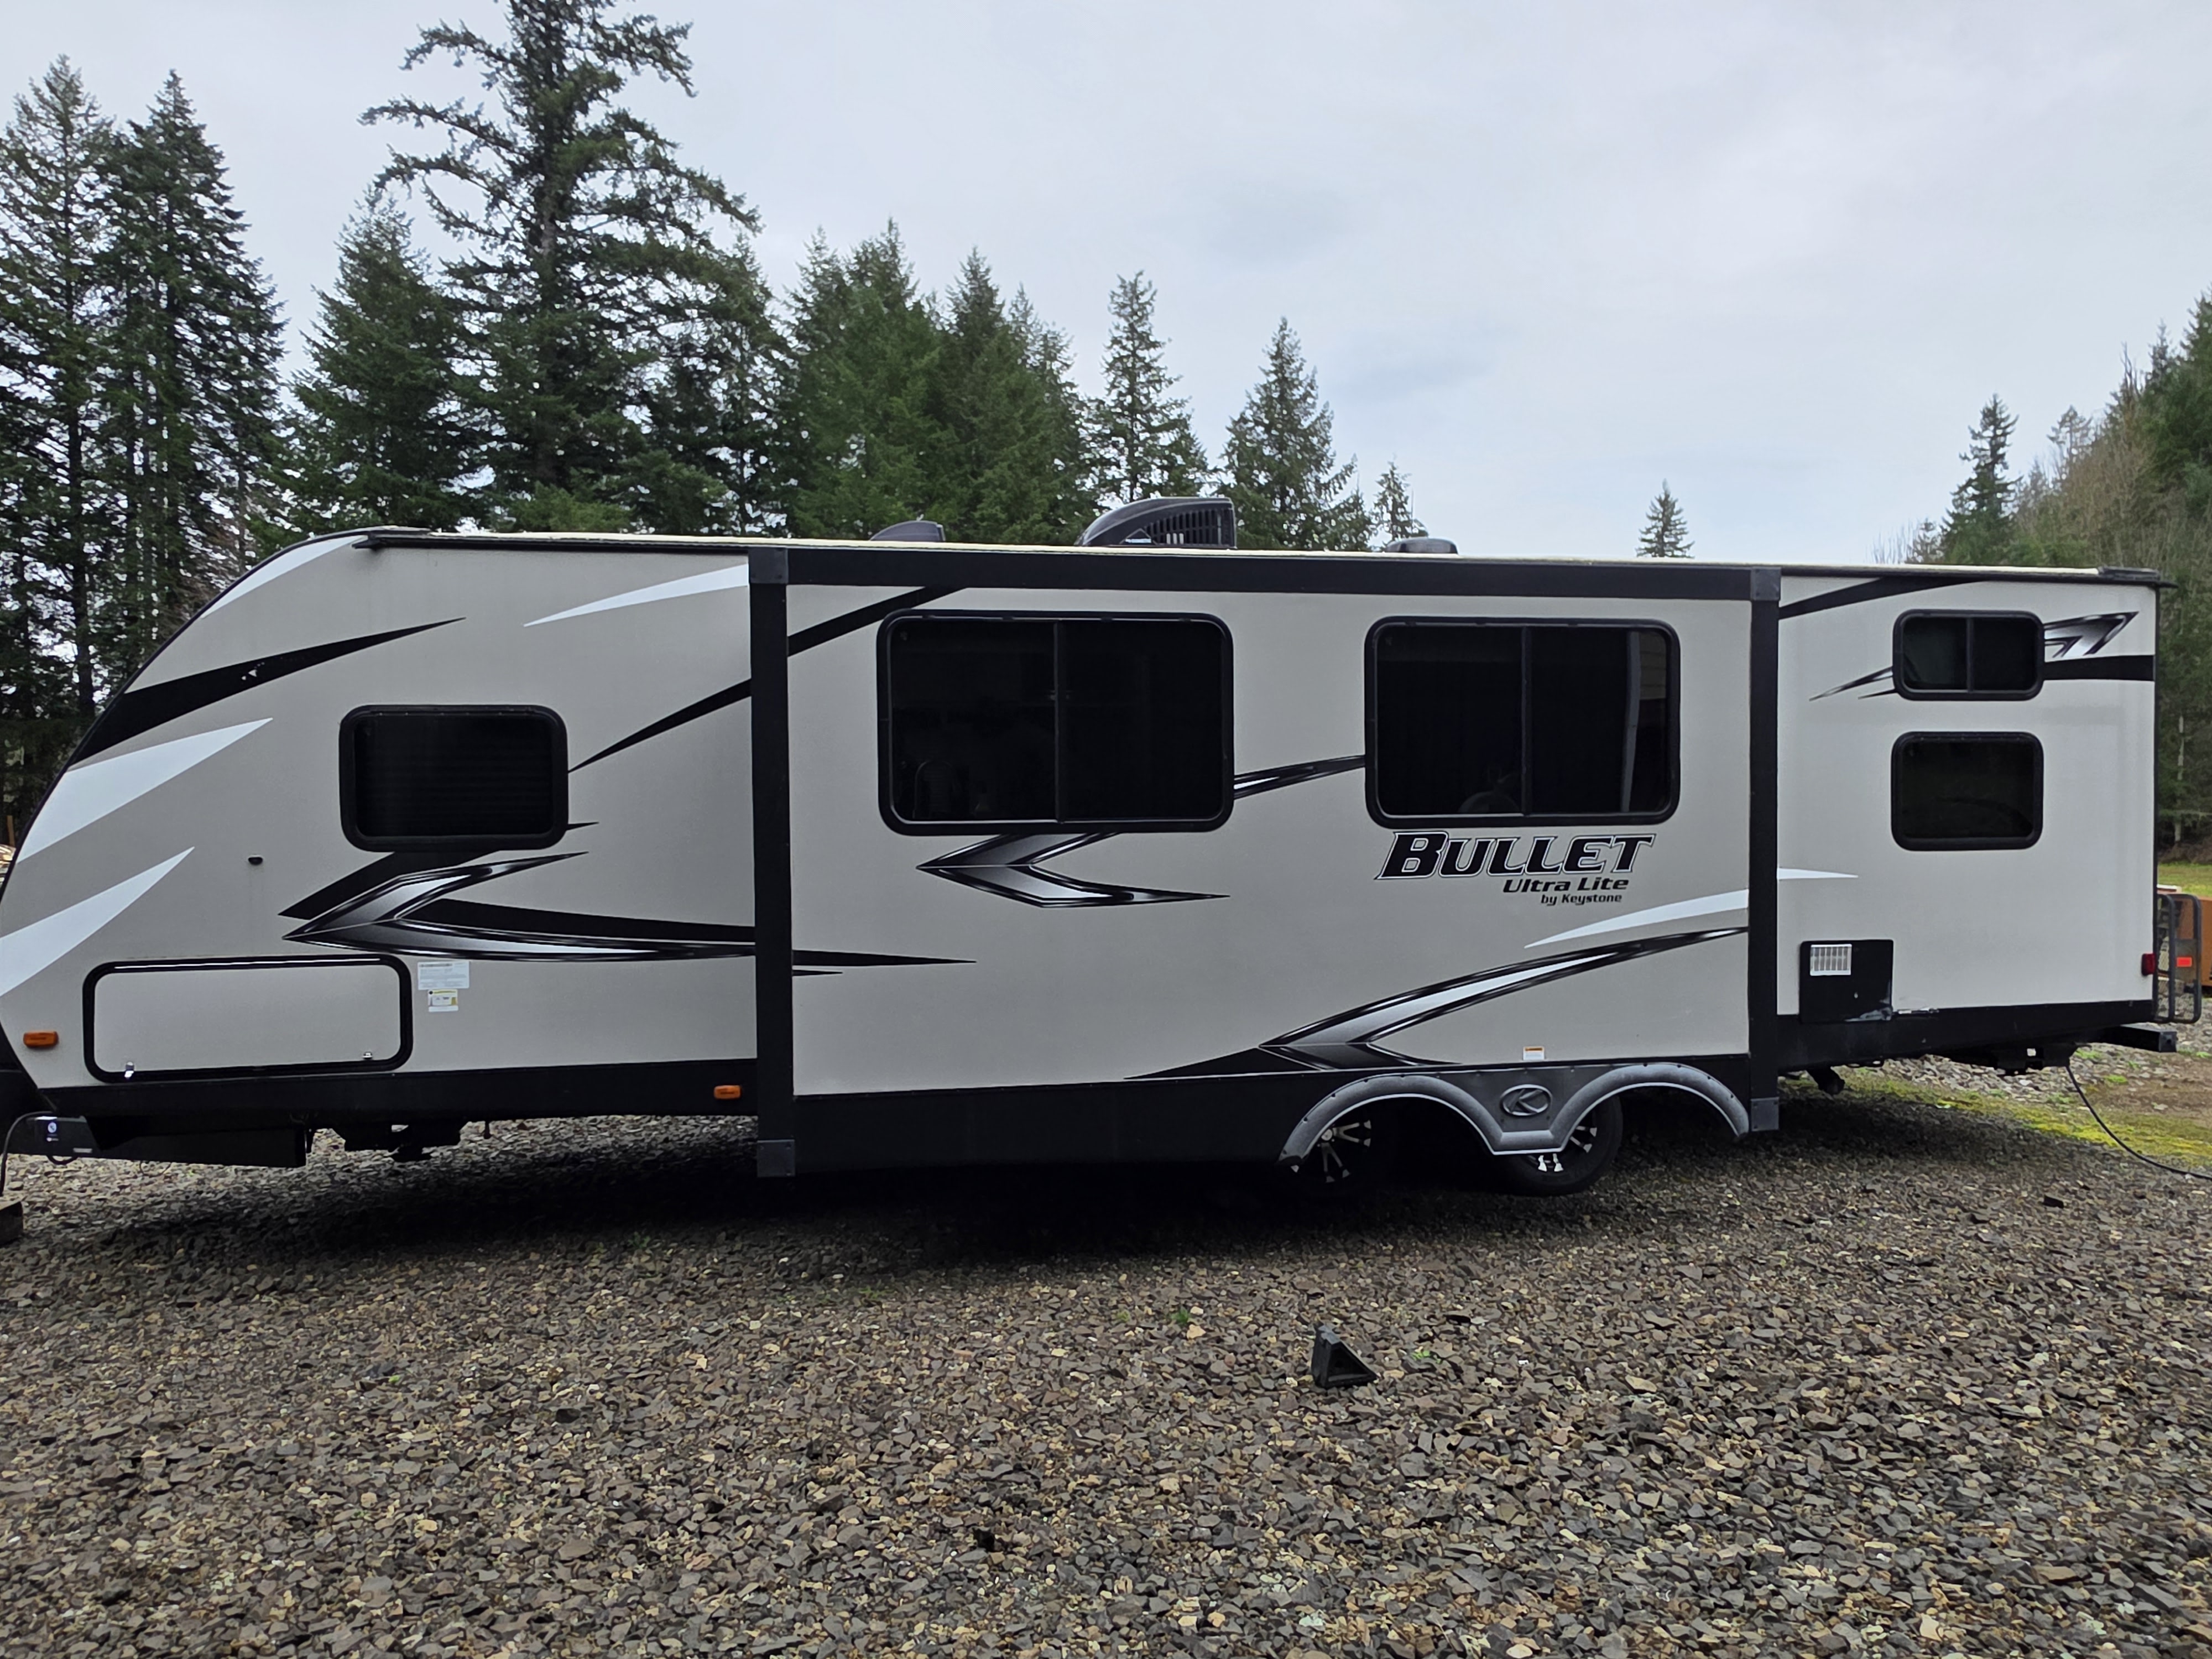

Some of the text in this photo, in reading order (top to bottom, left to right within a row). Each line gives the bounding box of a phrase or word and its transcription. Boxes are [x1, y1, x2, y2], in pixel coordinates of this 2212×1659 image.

[1374, 831, 1657, 880] BULLET
[1503, 877, 1629, 893] Ultra Lite
[1541, 894, 1623, 906] by Keystone
